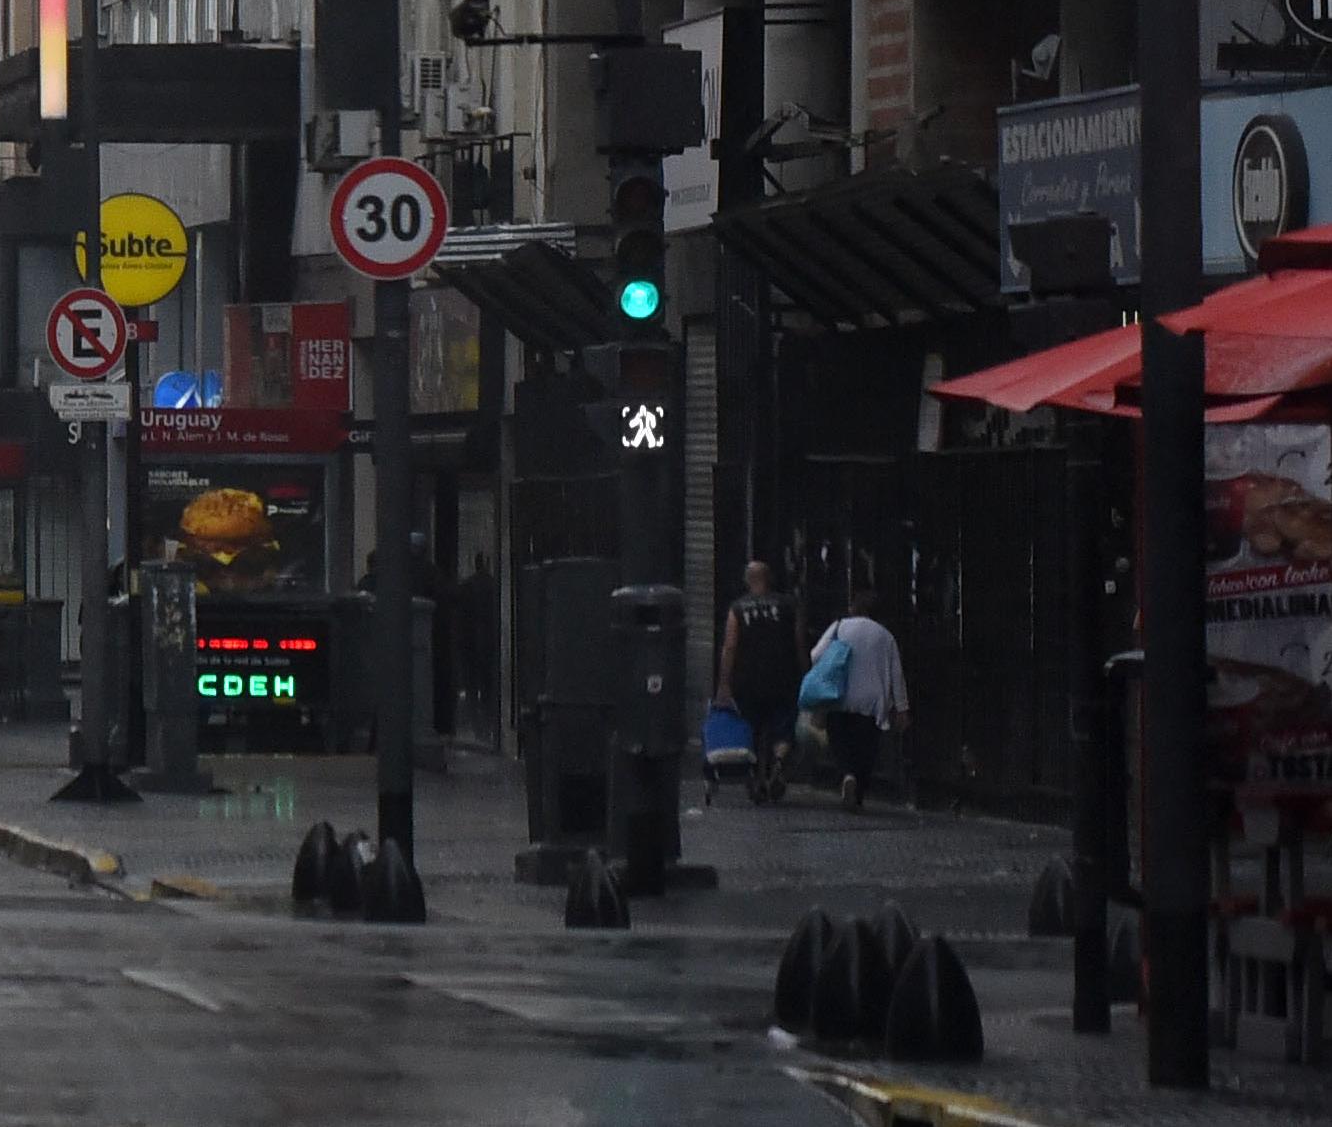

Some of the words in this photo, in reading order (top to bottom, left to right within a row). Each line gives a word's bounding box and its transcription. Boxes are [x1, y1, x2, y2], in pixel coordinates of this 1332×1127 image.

[1001, 105, 1141, 165] ESTACIONAMIENT
[356, 193, 421, 242] 30
[308, 339, 344, 352] HER
[308, 353, 344, 365] NAN
[308, 366, 344, 379] DEZ
[140, 410, 223, 431] Uruguay
